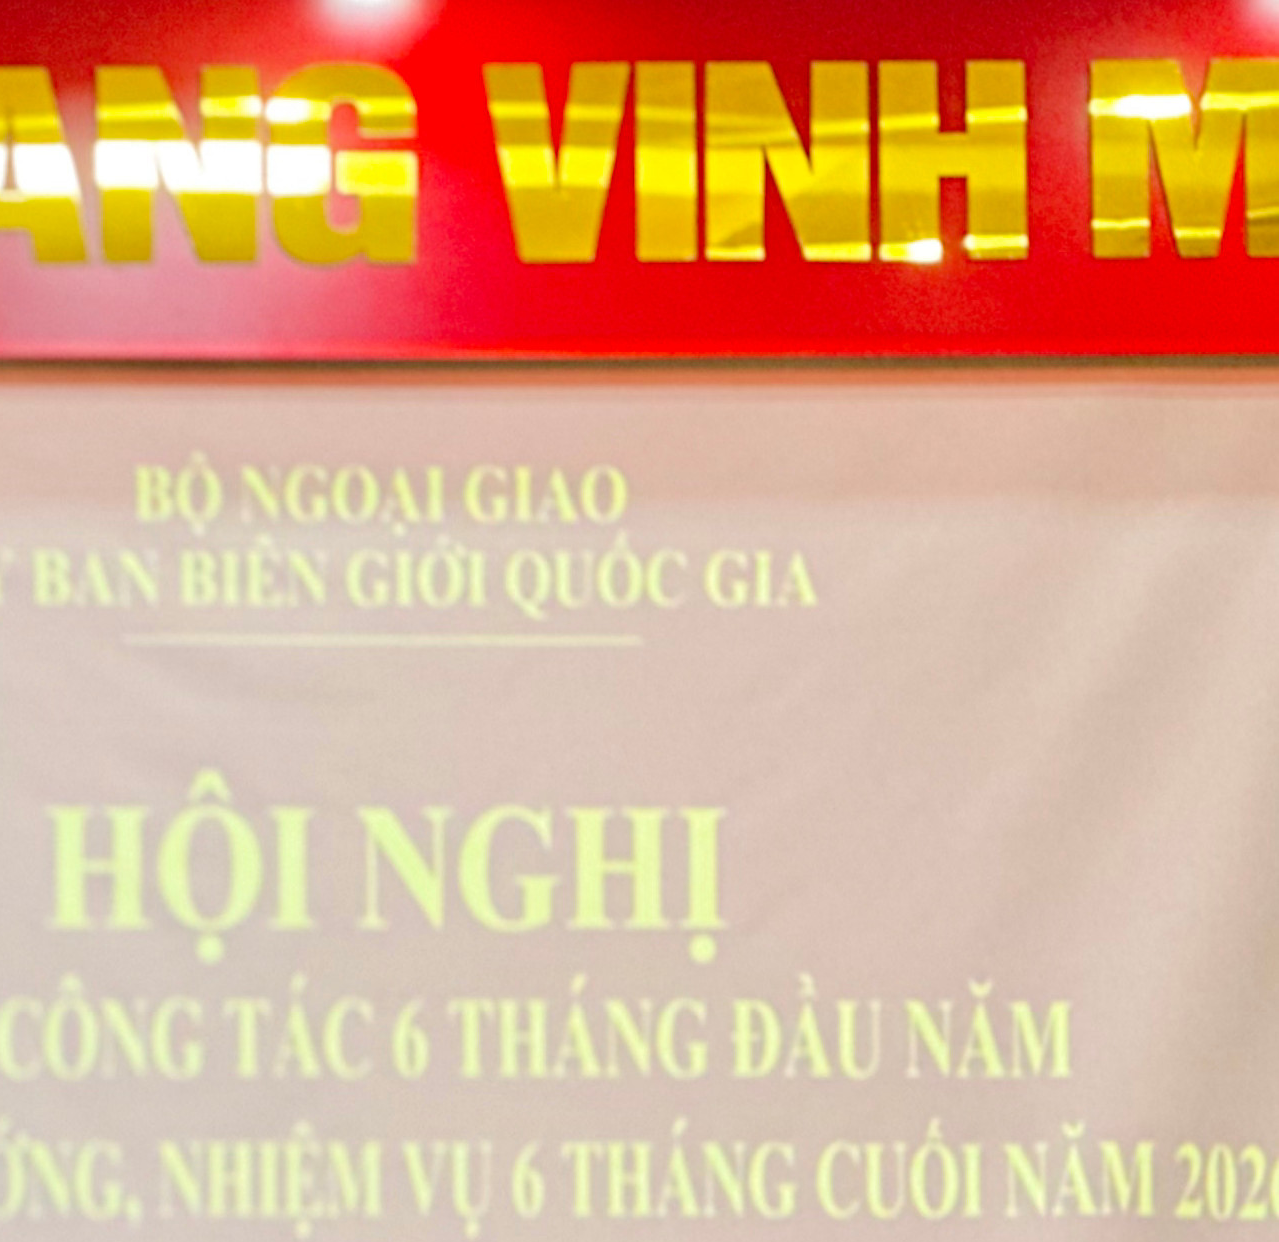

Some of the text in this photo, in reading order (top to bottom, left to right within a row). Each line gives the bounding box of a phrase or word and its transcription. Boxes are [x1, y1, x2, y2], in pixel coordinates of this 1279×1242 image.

[481, 60, 1028, 263] VINH
[133, 452, 632, 535] BỘ NGOẠI GIAO
[30, 547, 159, 608] BAN
[179, 535, 327, 607] BIÊN
[701, 549, 818, 608] GIA
[45, 768, 725, 964] HỘI NGHỊ
[225, 974, 372, 1080] TÁC
[389, 1002, 430, 1078] 6
[448, 973, 709, 1079] THÁNG
[902, 982, 1072, 1079] NĂM
[158, 1120, 383, 1240] NHIỆM
[402, 1140, 495, 1238] VỤ
[511, 1143, 545, 1216] 6
[562, 1119, 797, 1219] THÁNG
[1002, 1121, 1158, 1218] NĂM
